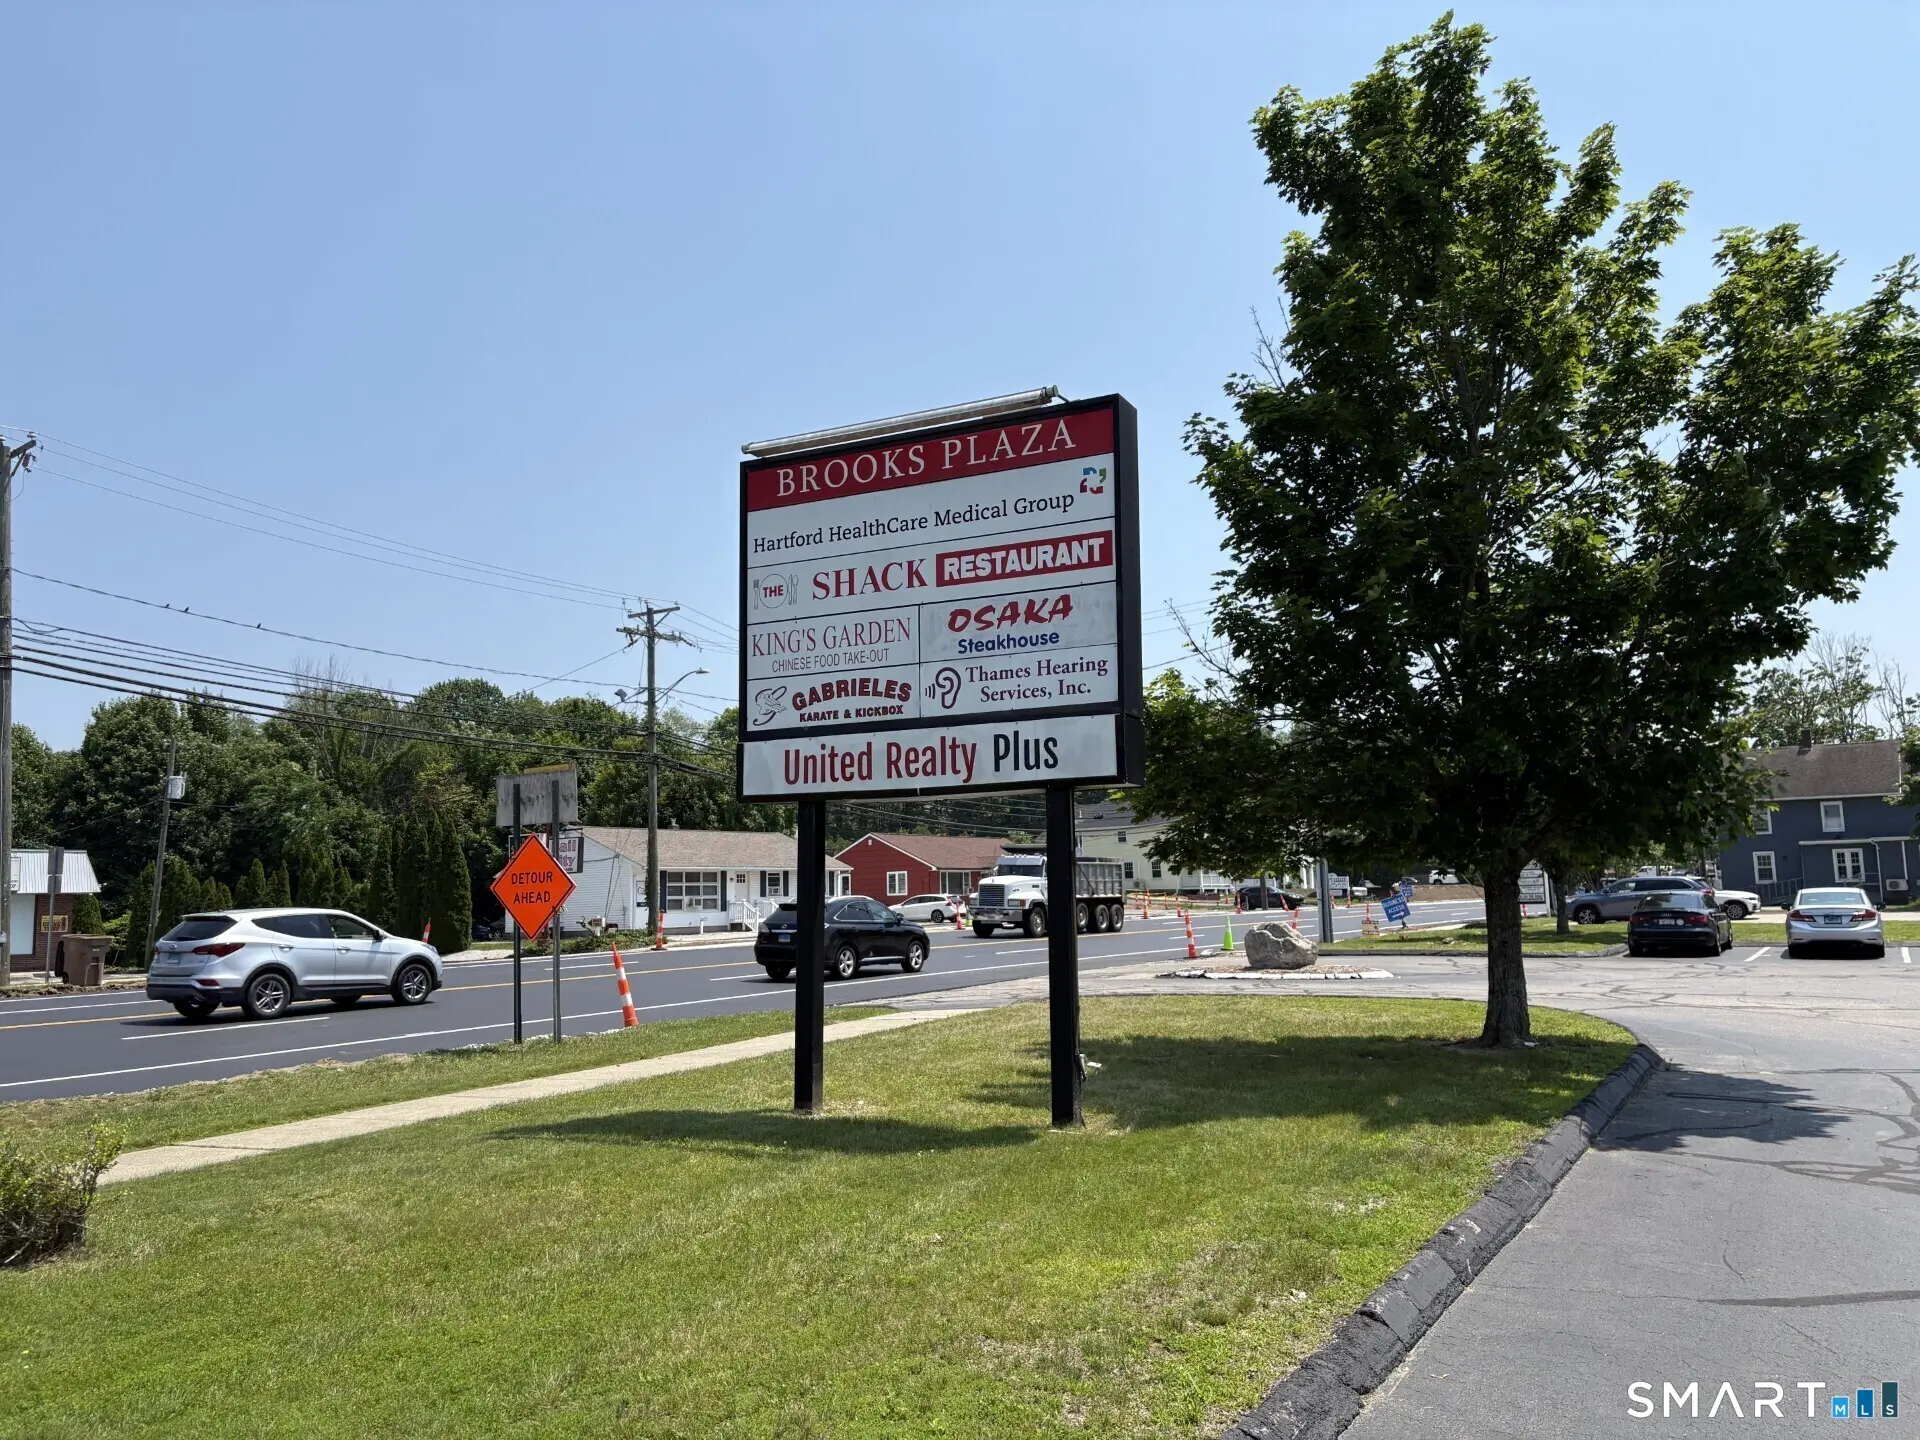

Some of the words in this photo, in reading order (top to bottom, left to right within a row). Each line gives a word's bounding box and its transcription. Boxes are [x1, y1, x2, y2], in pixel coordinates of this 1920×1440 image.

[777, 445, 925, 497] BROOKS
[942, 419, 1076, 470] PLAZA
[754, 527, 823, 553] Hartford
[829, 516, 928, 542] HealthCare
[934, 500, 1007, 527] Medical
[1014, 494, 1074, 513] Group
[762, 585, 783, 598] THE
[812, 558, 928, 599] SHACK
[944, 538, 1104, 580] RESTAURANT
[948, 593, 1073, 632] OSAKA
[752, 627, 817, 657] KING'S
[824, 618, 911, 646] GARDEN
[958, 631, 1059, 655] Steakhouse
[772, 656, 811, 672] CHINESE
[814, 654, 840, 669] FOOD
[843, 649, 889, 666] TAKE-OUT
[965, 664, 1031, 683] Thames
[1036, 656, 1108, 677] Hearing
[792, 677, 912, 711] GABRIELES
[980, 682, 1052, 702] Services,
[1058, 679, 1091, 696] Inc.
[800, 710, 839, 722] KARATE
[844, 709, 852, 718] &
[855, 705, 903, 718] KICKBOX
[784, 742, 873, 785] United
[886, 736, 977, 783] Realty
[993, 730, 1058, 772] Plus
[559, 839, 576, 852] ail
[512, 872, 552, 884] DETOUR
[514, 891, 550, 904] AHEAD
